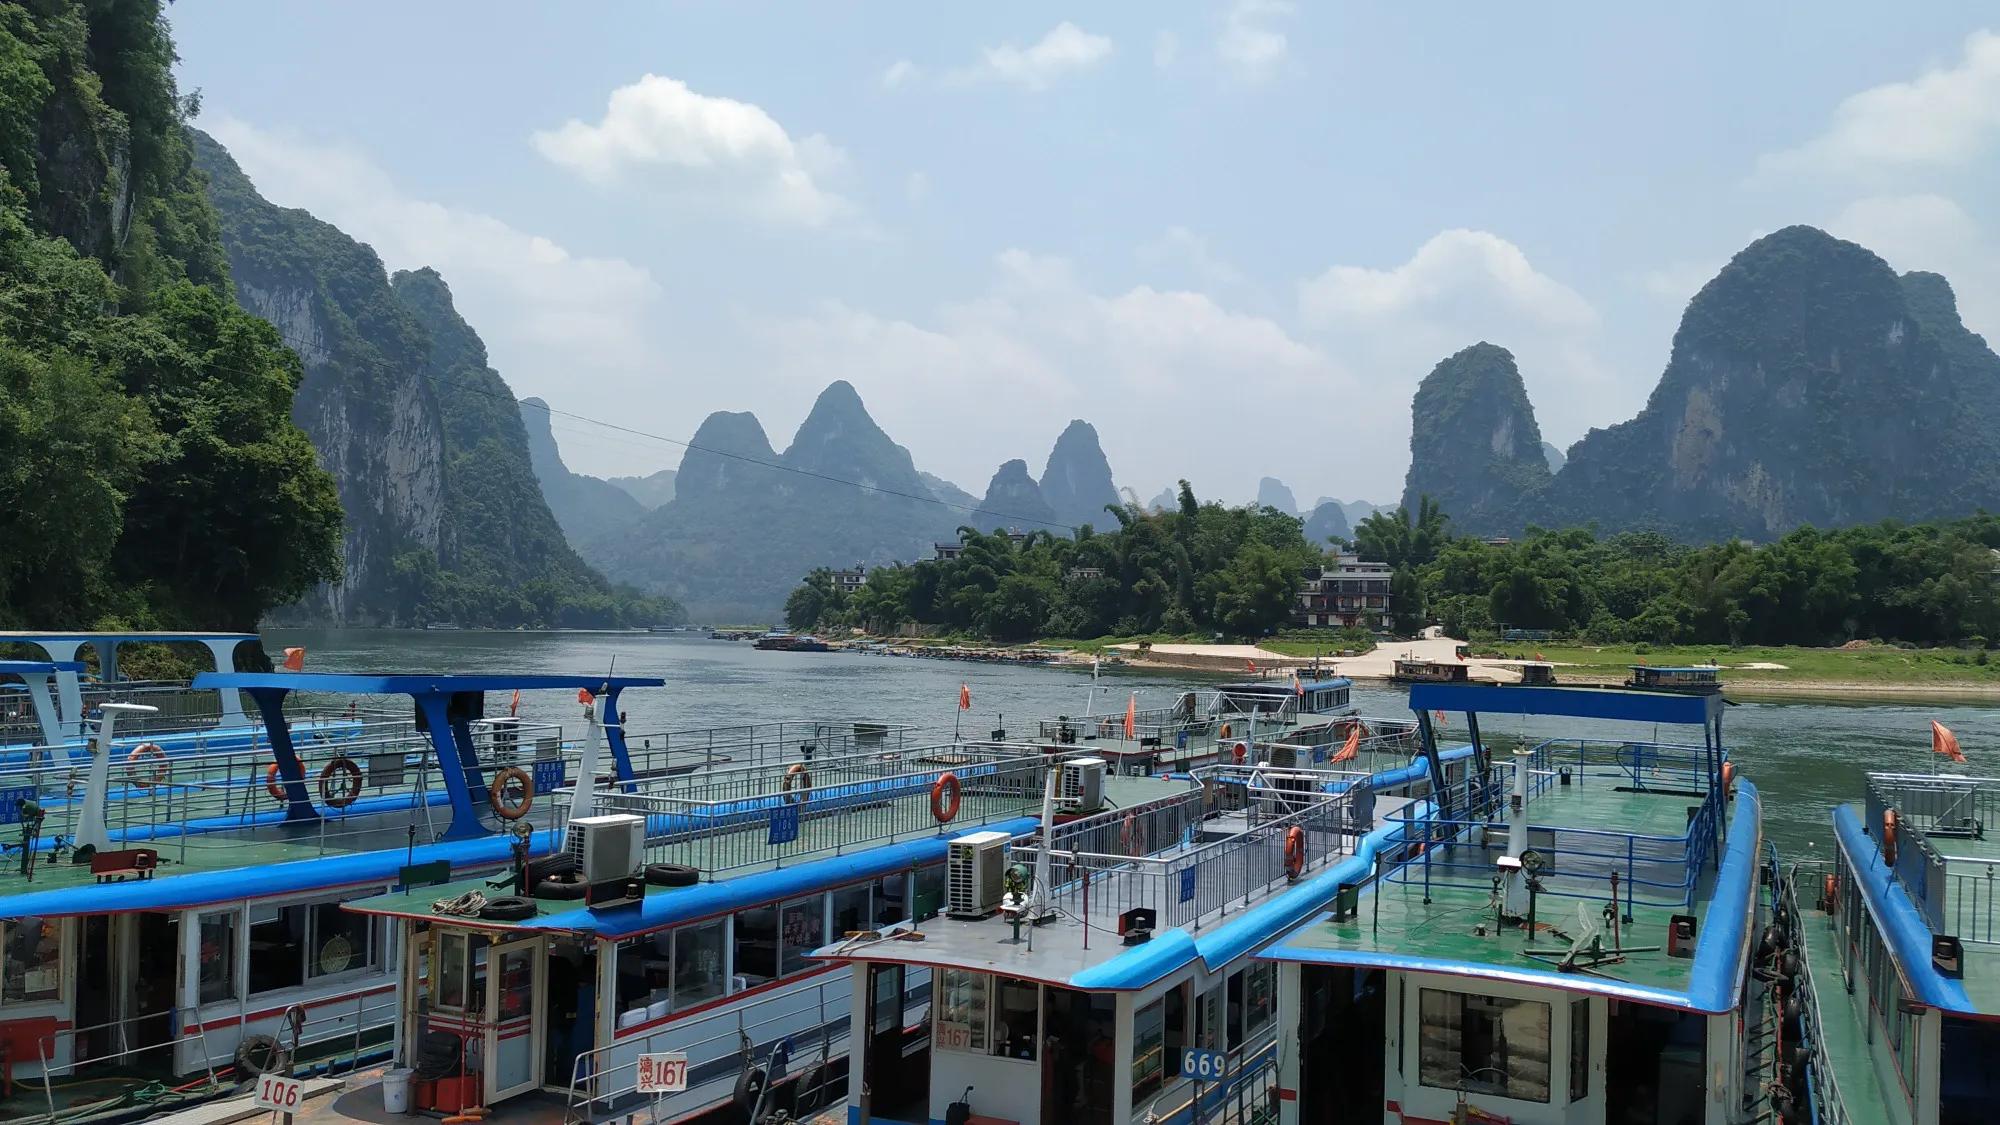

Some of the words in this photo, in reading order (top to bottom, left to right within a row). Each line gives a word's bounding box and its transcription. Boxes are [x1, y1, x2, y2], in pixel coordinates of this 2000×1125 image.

[946, 1029, 970, 1047] 167
[654, 1060, 687, 1086] 167
[1184, 1050, 1226, 1078] 669
[261, 1079, 299, 1107] 106
